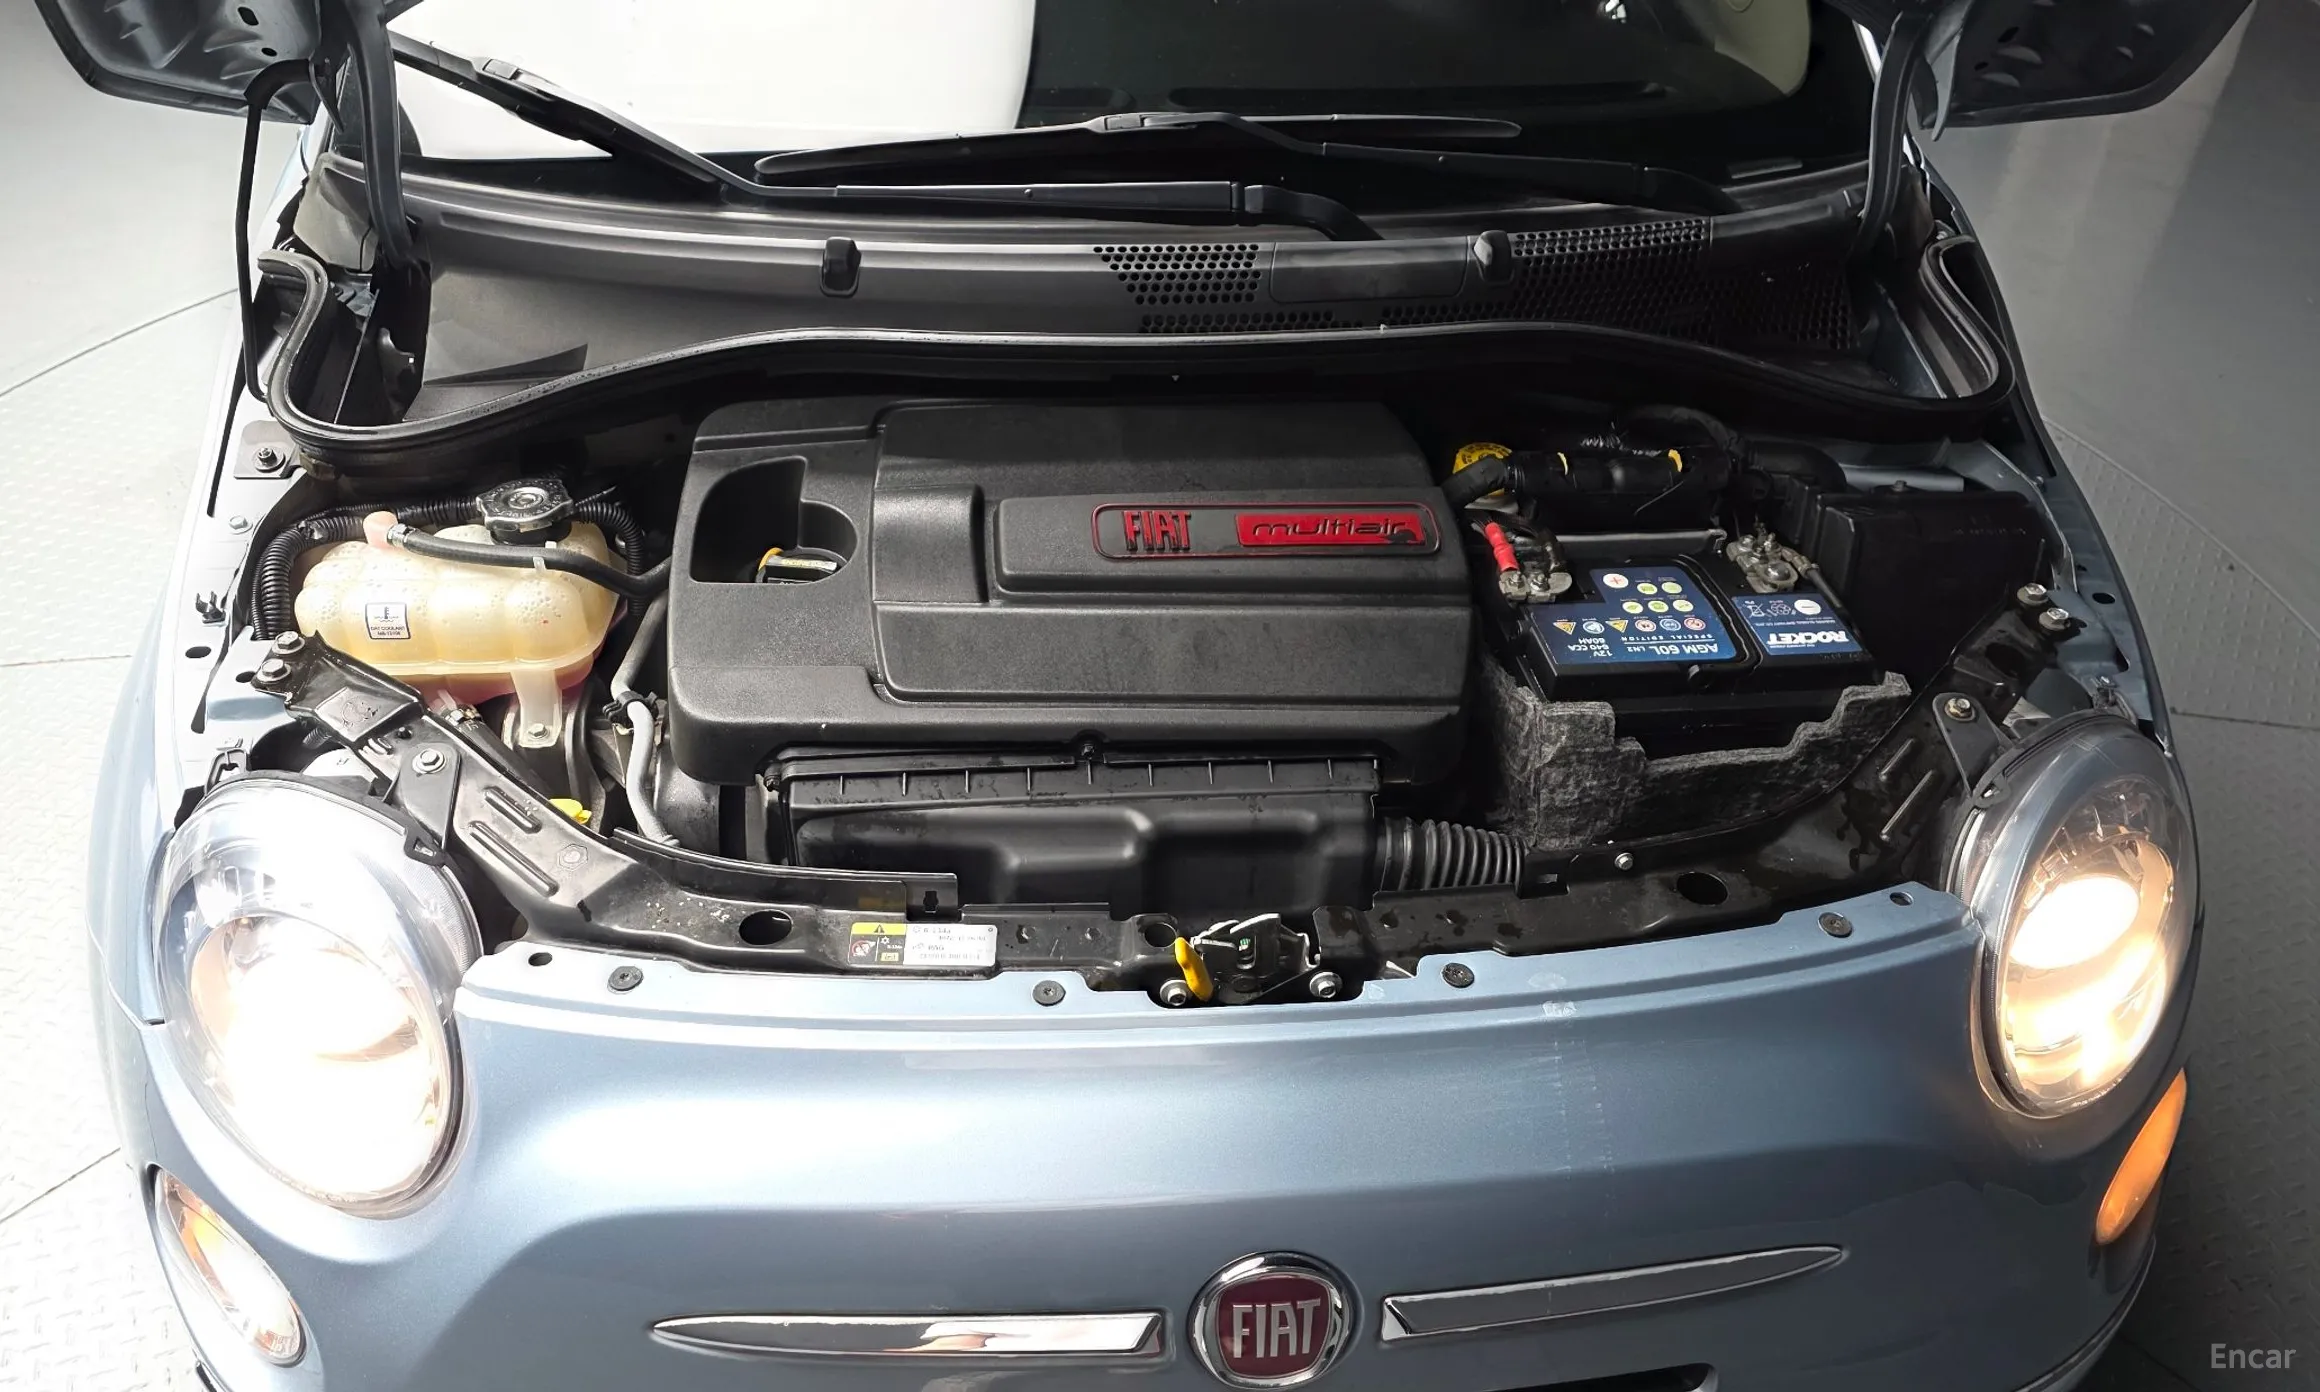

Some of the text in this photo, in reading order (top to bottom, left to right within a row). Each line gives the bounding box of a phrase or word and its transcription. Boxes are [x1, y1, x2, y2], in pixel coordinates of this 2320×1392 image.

[1122, 510, 1405, 551] FIAT multiair
[1767, 631, 1849, 645] ROCKET
[1649, 645, 1681, 655] 60L
[1682, 643, 1719, 654] AGM
[1232, 1298, 1321, 1359] FIAT
